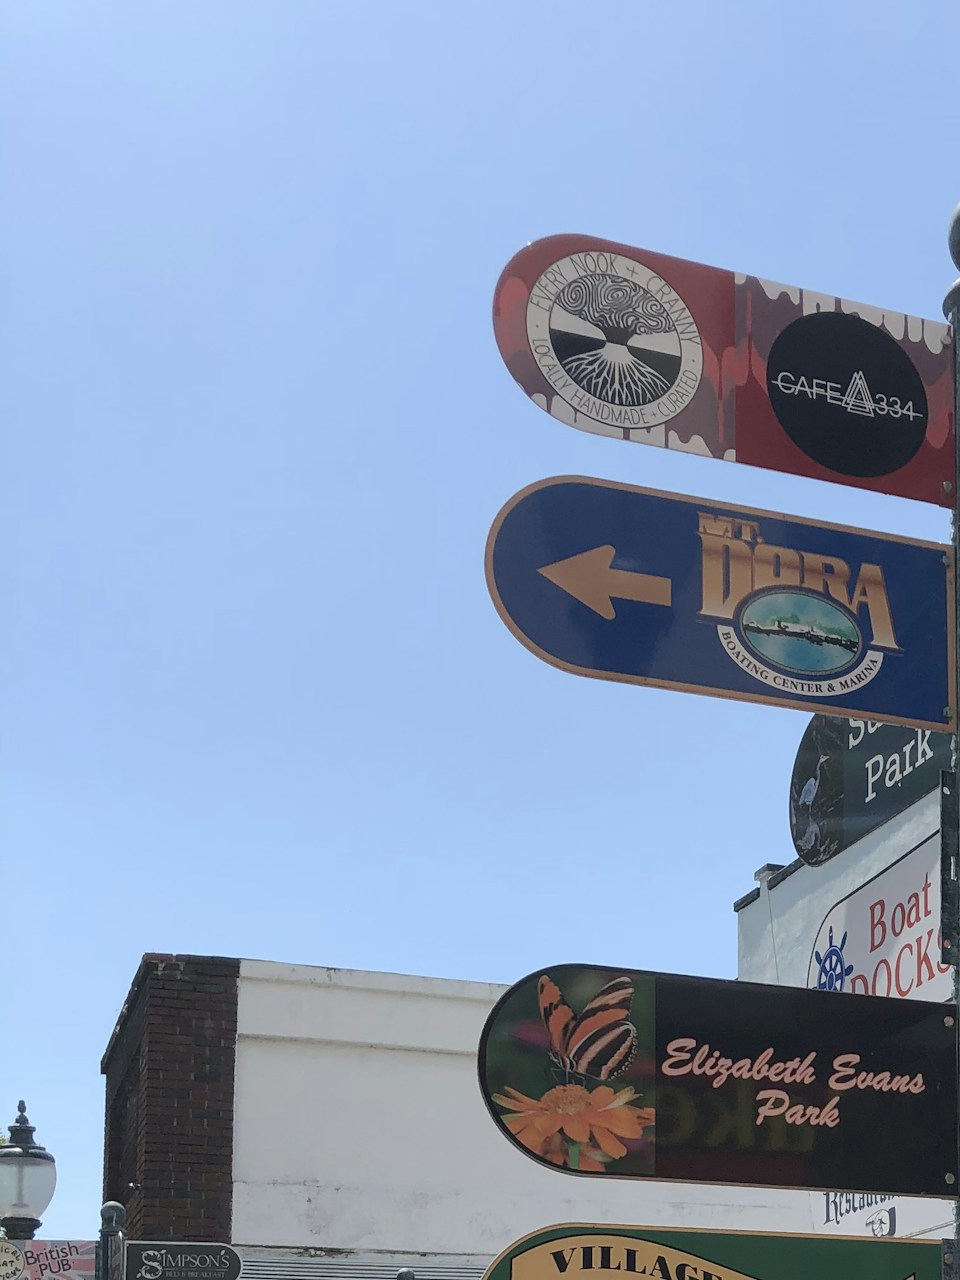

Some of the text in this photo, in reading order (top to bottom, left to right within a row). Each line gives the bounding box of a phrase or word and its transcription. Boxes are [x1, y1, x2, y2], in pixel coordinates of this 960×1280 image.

[530, 264, 569, 312] EVERY
[569, 253, 619, 277] NOOK
[646, 275, 701, 346] CRANNY
[532, 338, 572, 391] LOCALLY
[569, 389, 650, 425] HANDMADE
[657, 369, 698, 417] CURATED
[773, 370, 920, 421] CAFE 334
[721, 631, 878, 694] BOATING CENTER & MARINA
[865, 730, 934, 803] Park
[869, 872, 932, 953] Boat
[661, 1037, 926, 1095] Elizabeth Evans
[755, 1089, 841, 1129] Park
[24, 1241, 79, 1266] British
[38, 1258, 72, 1277] PUB
